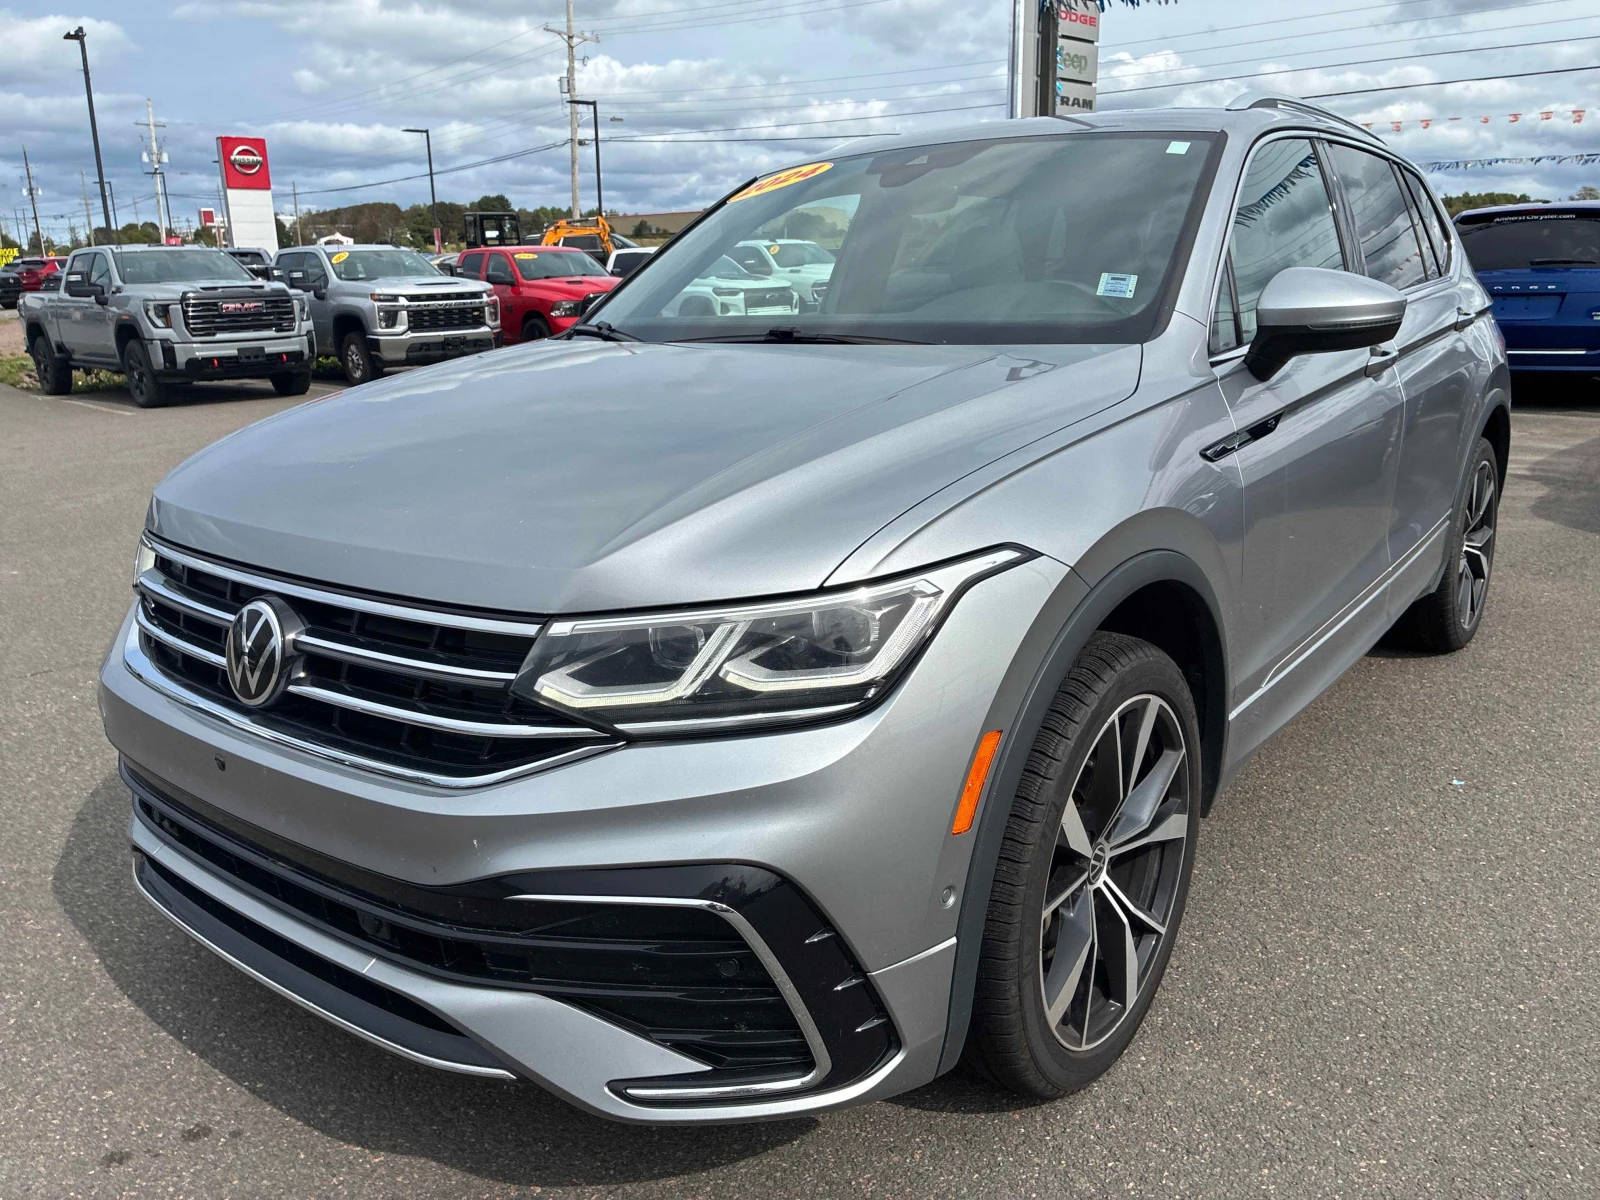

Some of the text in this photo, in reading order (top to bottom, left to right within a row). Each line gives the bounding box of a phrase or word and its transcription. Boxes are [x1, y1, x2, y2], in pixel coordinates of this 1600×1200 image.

[1058, 9, 1097, 27] ODGE
[1060, 95, 1093, 111] RAM
[233, 156, 261, 164] NISSAN
[734, 163, 827, 199] 2024
[222, 302, 263, 313] GMC
